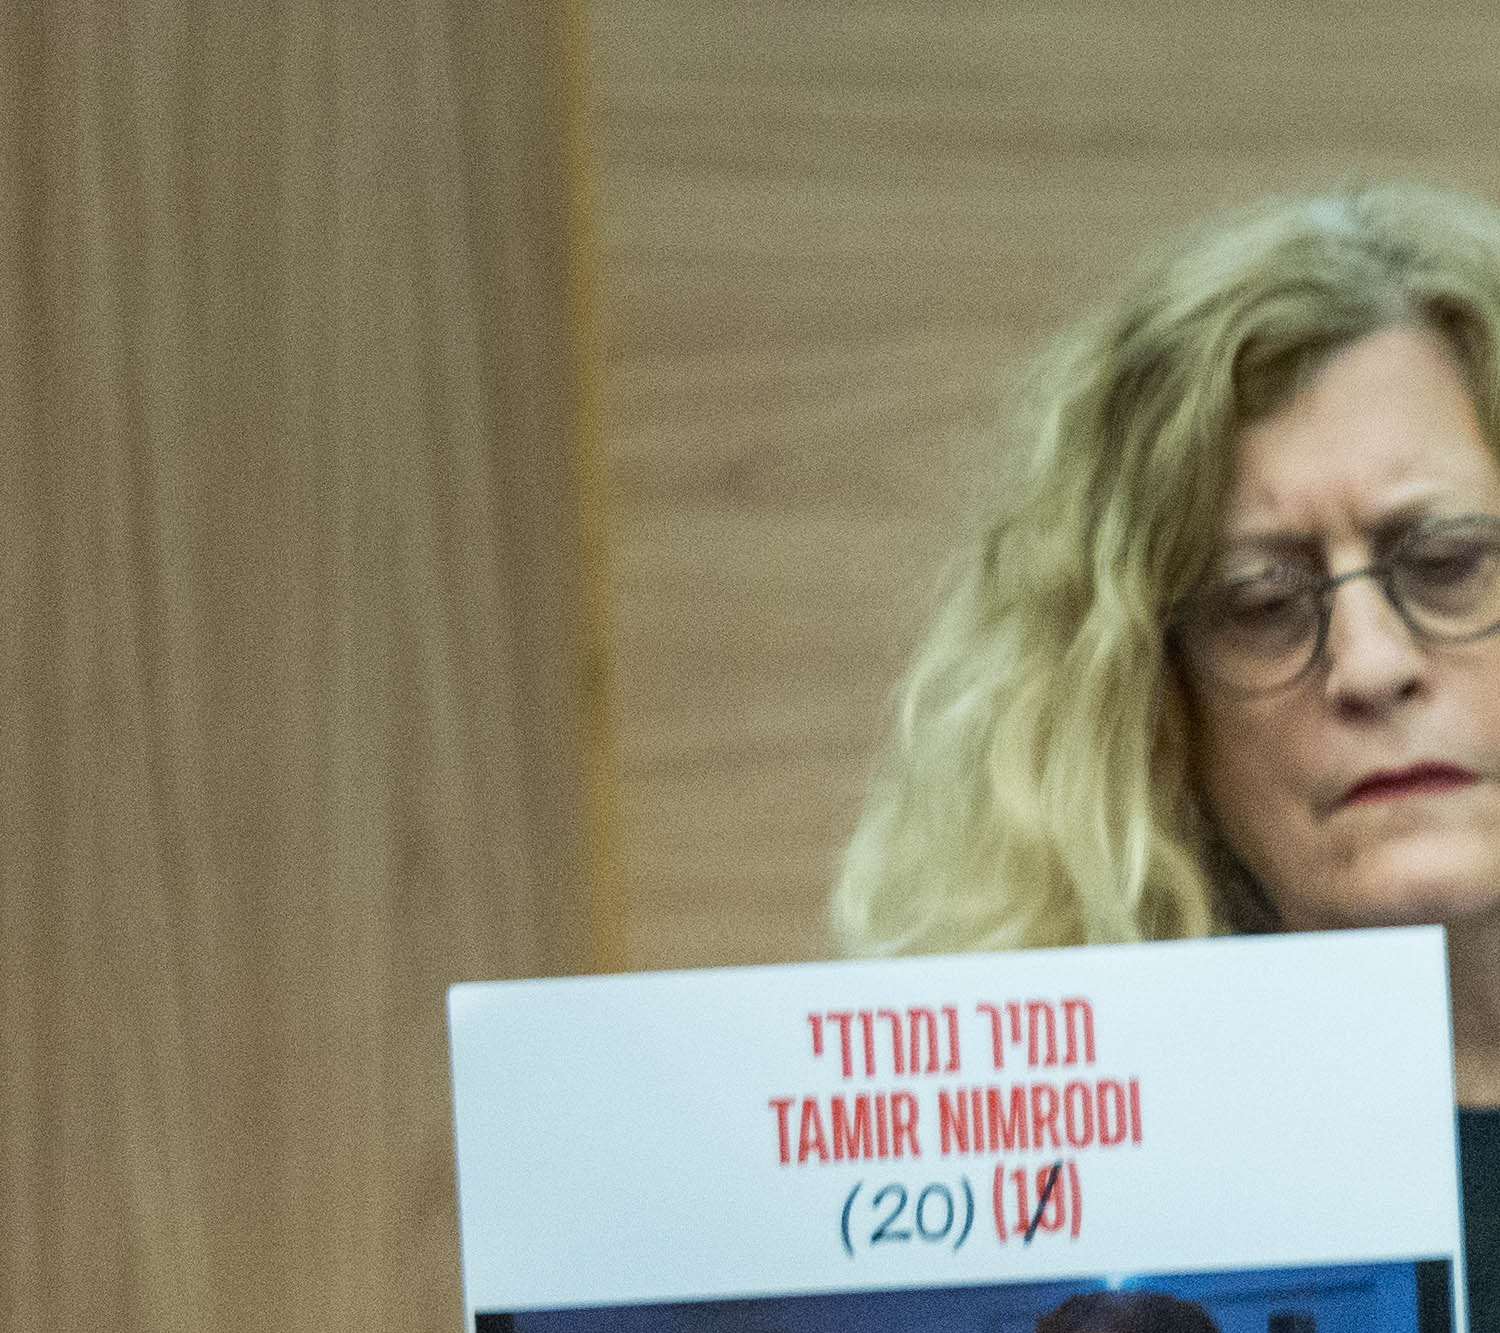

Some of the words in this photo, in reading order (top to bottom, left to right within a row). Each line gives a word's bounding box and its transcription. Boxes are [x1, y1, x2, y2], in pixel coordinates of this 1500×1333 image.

[807, 1003, 960, 1079] נמרודי
[976, 995, 1096, 1071] תמיר
[767, 1089, 922, 1166] TAMIR
[937, 1076, 1143, 1157] NIMRODI
[841, 1176, 975, 1256] (20)
